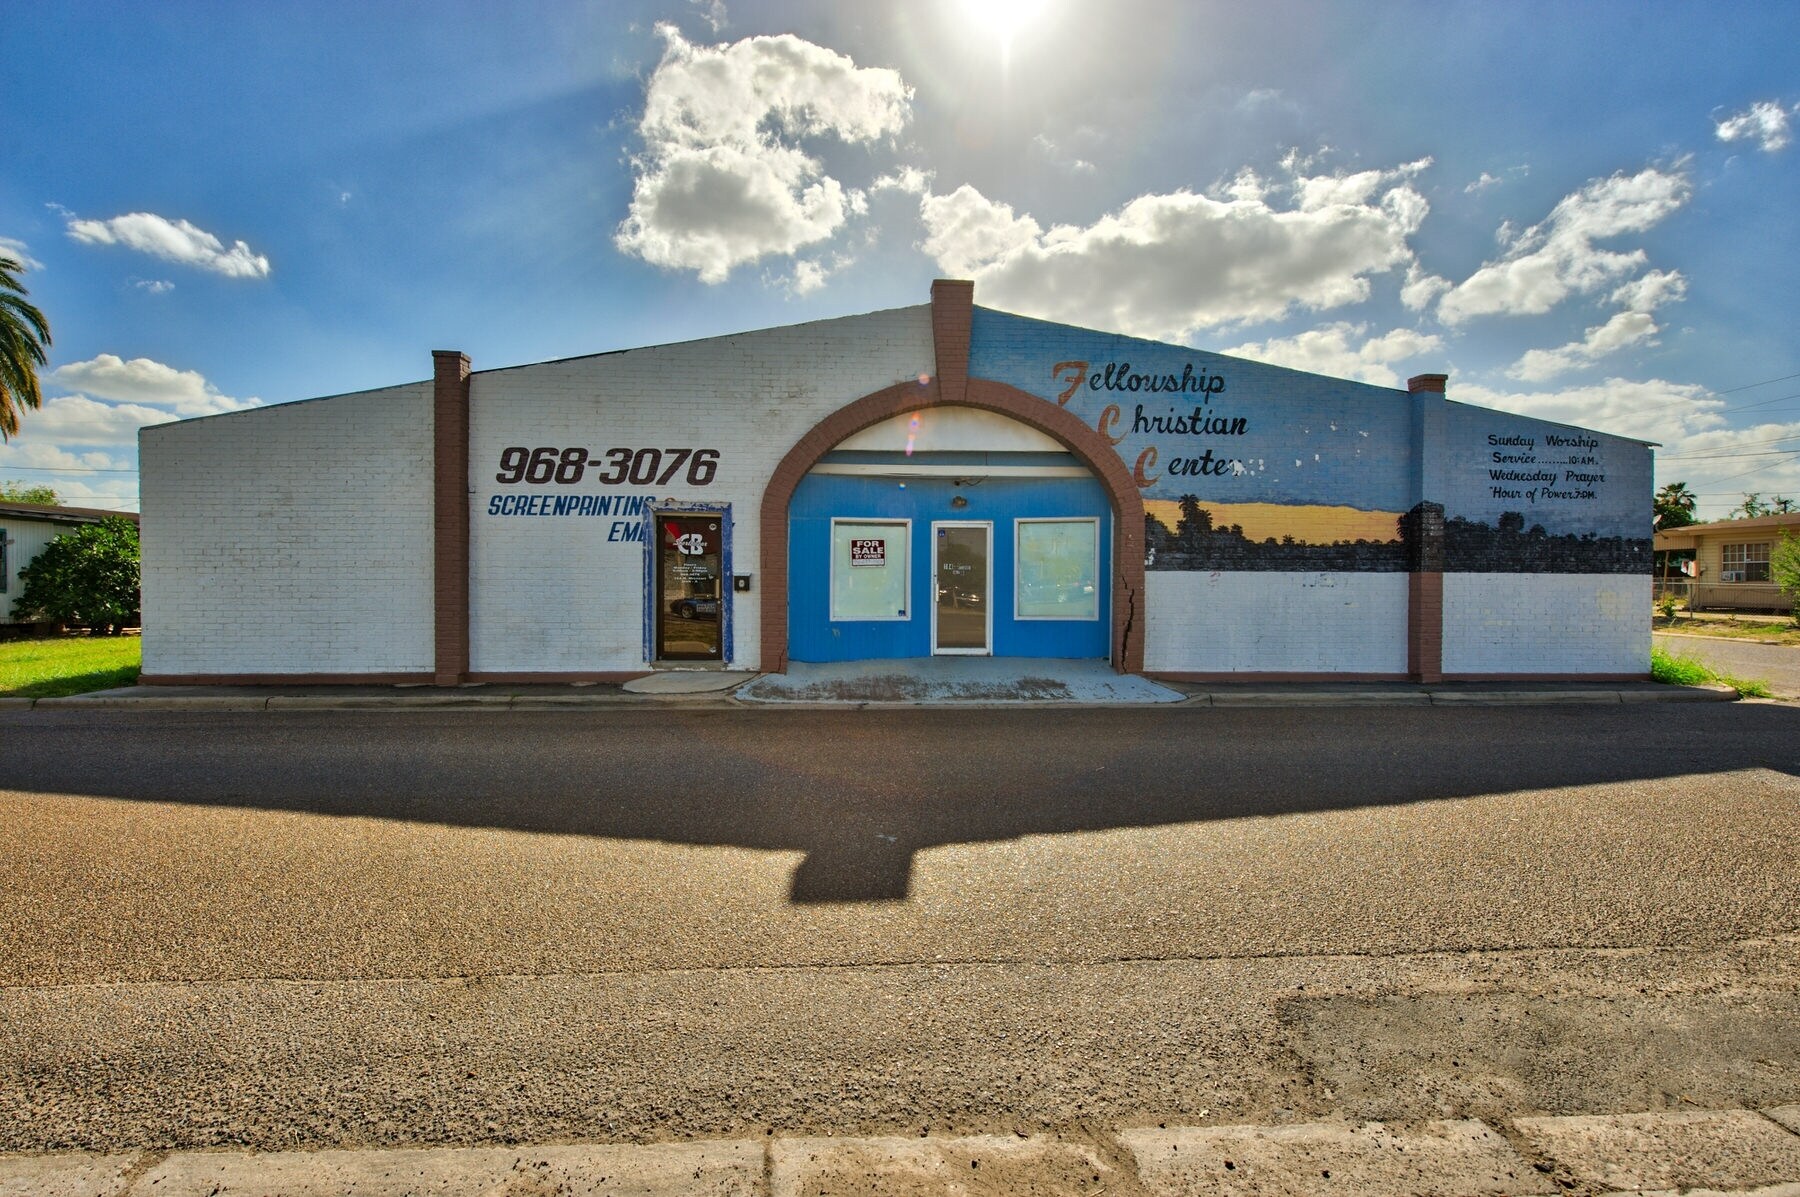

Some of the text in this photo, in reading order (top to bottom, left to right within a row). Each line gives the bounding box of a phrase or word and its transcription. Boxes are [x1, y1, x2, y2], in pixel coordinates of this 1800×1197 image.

[1052, 360, 1226, 407] Fellowship
[1097, 403, 1249, 446] Christian
[1487, 434, 1599, 453] Sunday Worship
[496, 446, 721, 486] 968-3076
[1492, 451, 1537, 464] Service
[1488, 469, 1606, 487] Wednesday Prayer
[1525, 487, 1538, 504] of
[852, 547, 884, 555] SALE
[856, 540, 880, 548] FOR
